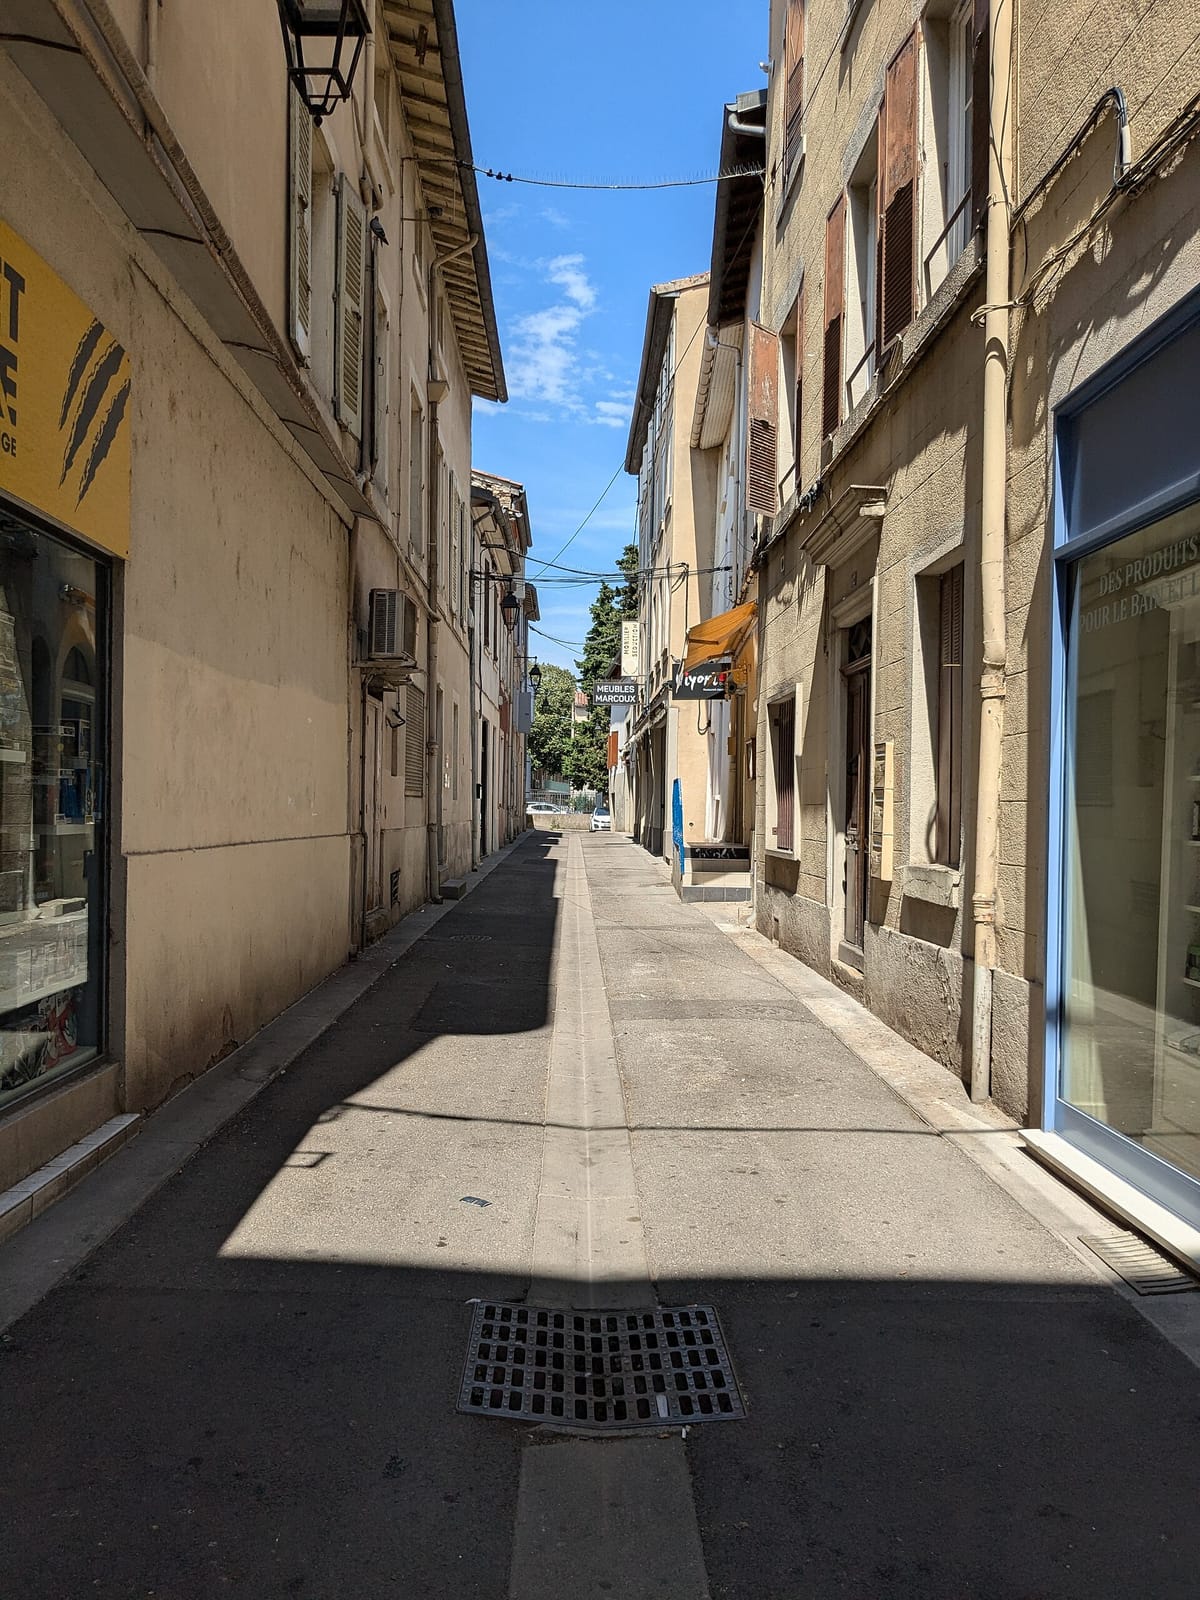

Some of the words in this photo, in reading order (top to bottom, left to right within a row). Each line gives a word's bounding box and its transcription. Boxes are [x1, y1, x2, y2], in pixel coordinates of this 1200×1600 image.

[0, 256, 26, 342] T
[1099, 567, 1123, 597] DES
[1124, 535, 1198, 587] PRODUITS
[1080, 604, 1110, 633] POUR
[1111, 598, 1128, 624] LE
[595, 694, 636, 703] MARCOUX
[596, 684, 635, 693] MEUBLES
